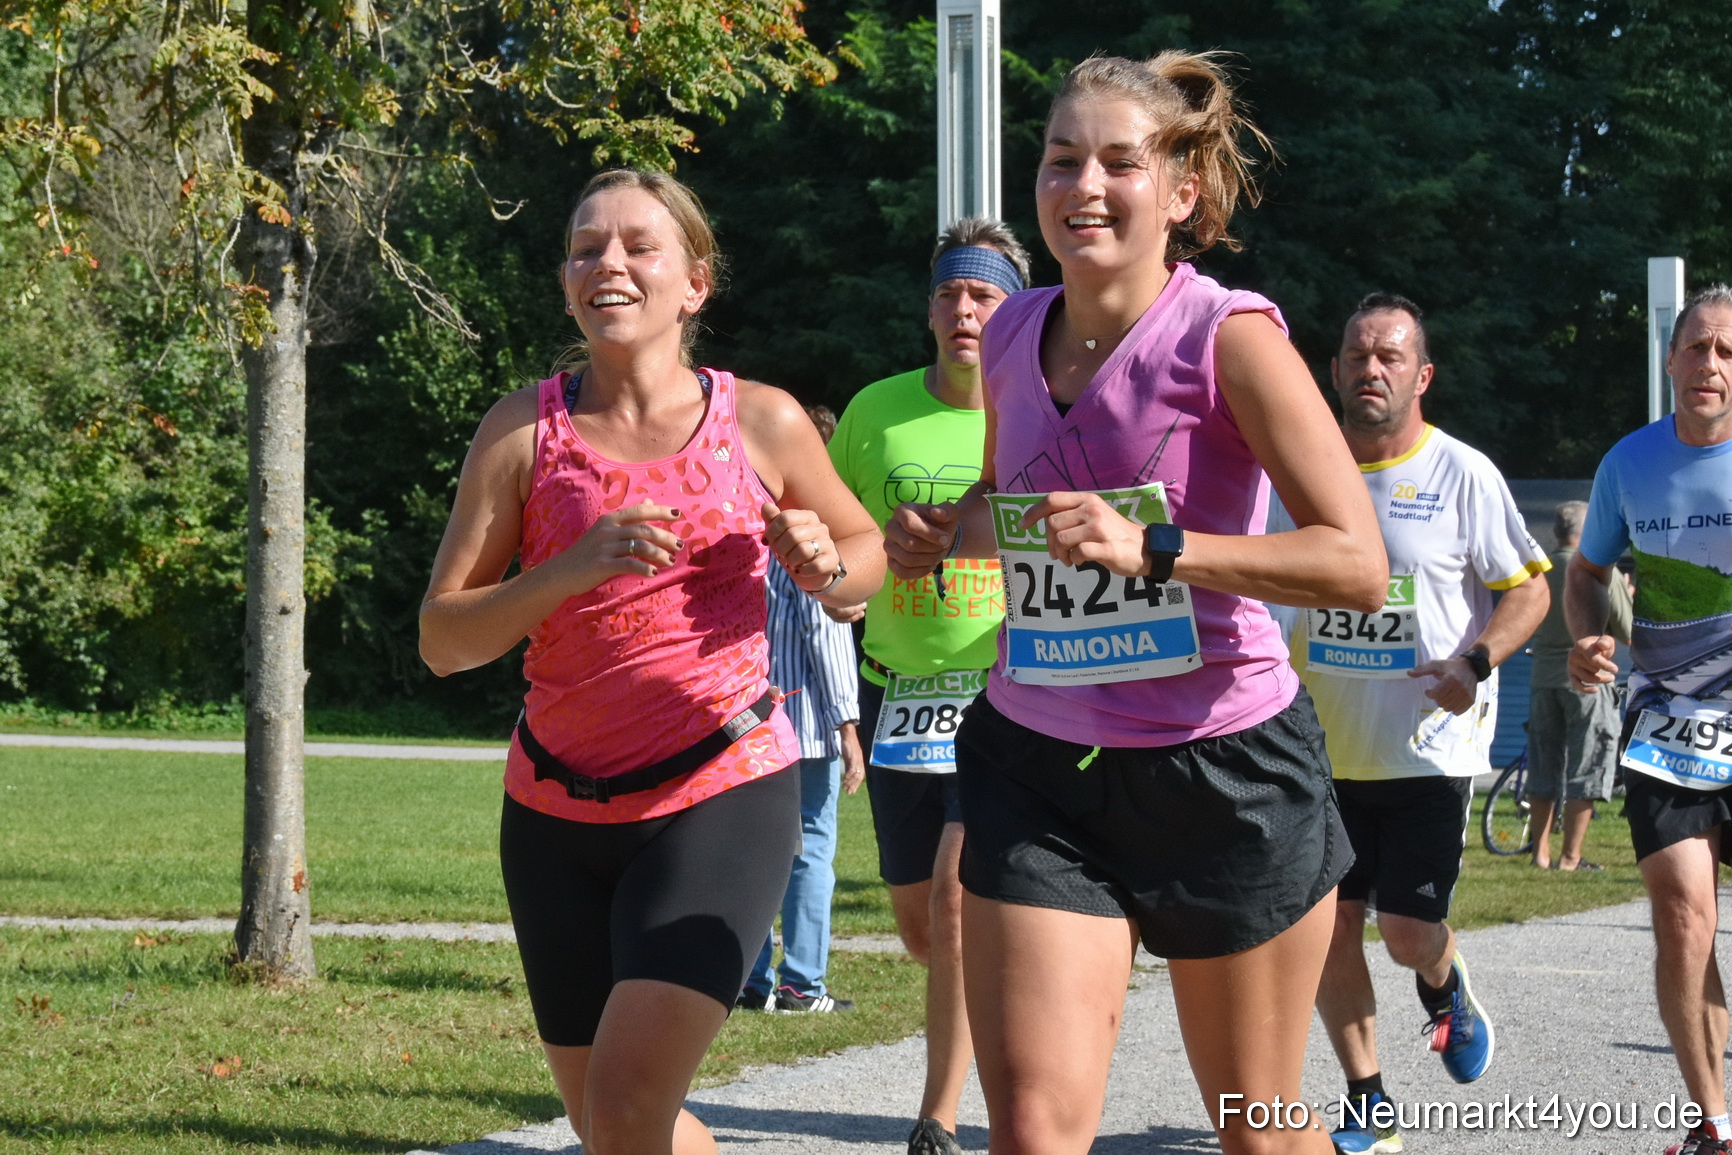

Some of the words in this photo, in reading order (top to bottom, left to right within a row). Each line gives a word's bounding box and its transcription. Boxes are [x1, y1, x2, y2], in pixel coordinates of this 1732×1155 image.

[1393, 484, 1416, 499] 20
[1389, 511, 1432, 523] Stadtlauf
[1391, 501, 1444, 512] Neumarkter
[1014, 561, 1163, 618] 2424
[893, 594, 1006, 617] REISEN
[1317, 609, 1402, 642] 2342
[1034, 631, 1158, 662] RAMONA
[1325, 648, 1393, 666] RONALD
[895, 671, 979, 696] BOCK
[890, 704, 970, 737] 208
[907, 744, 955, 761] JÖRG
[1651, 750, 1729, 780] THOMAS
